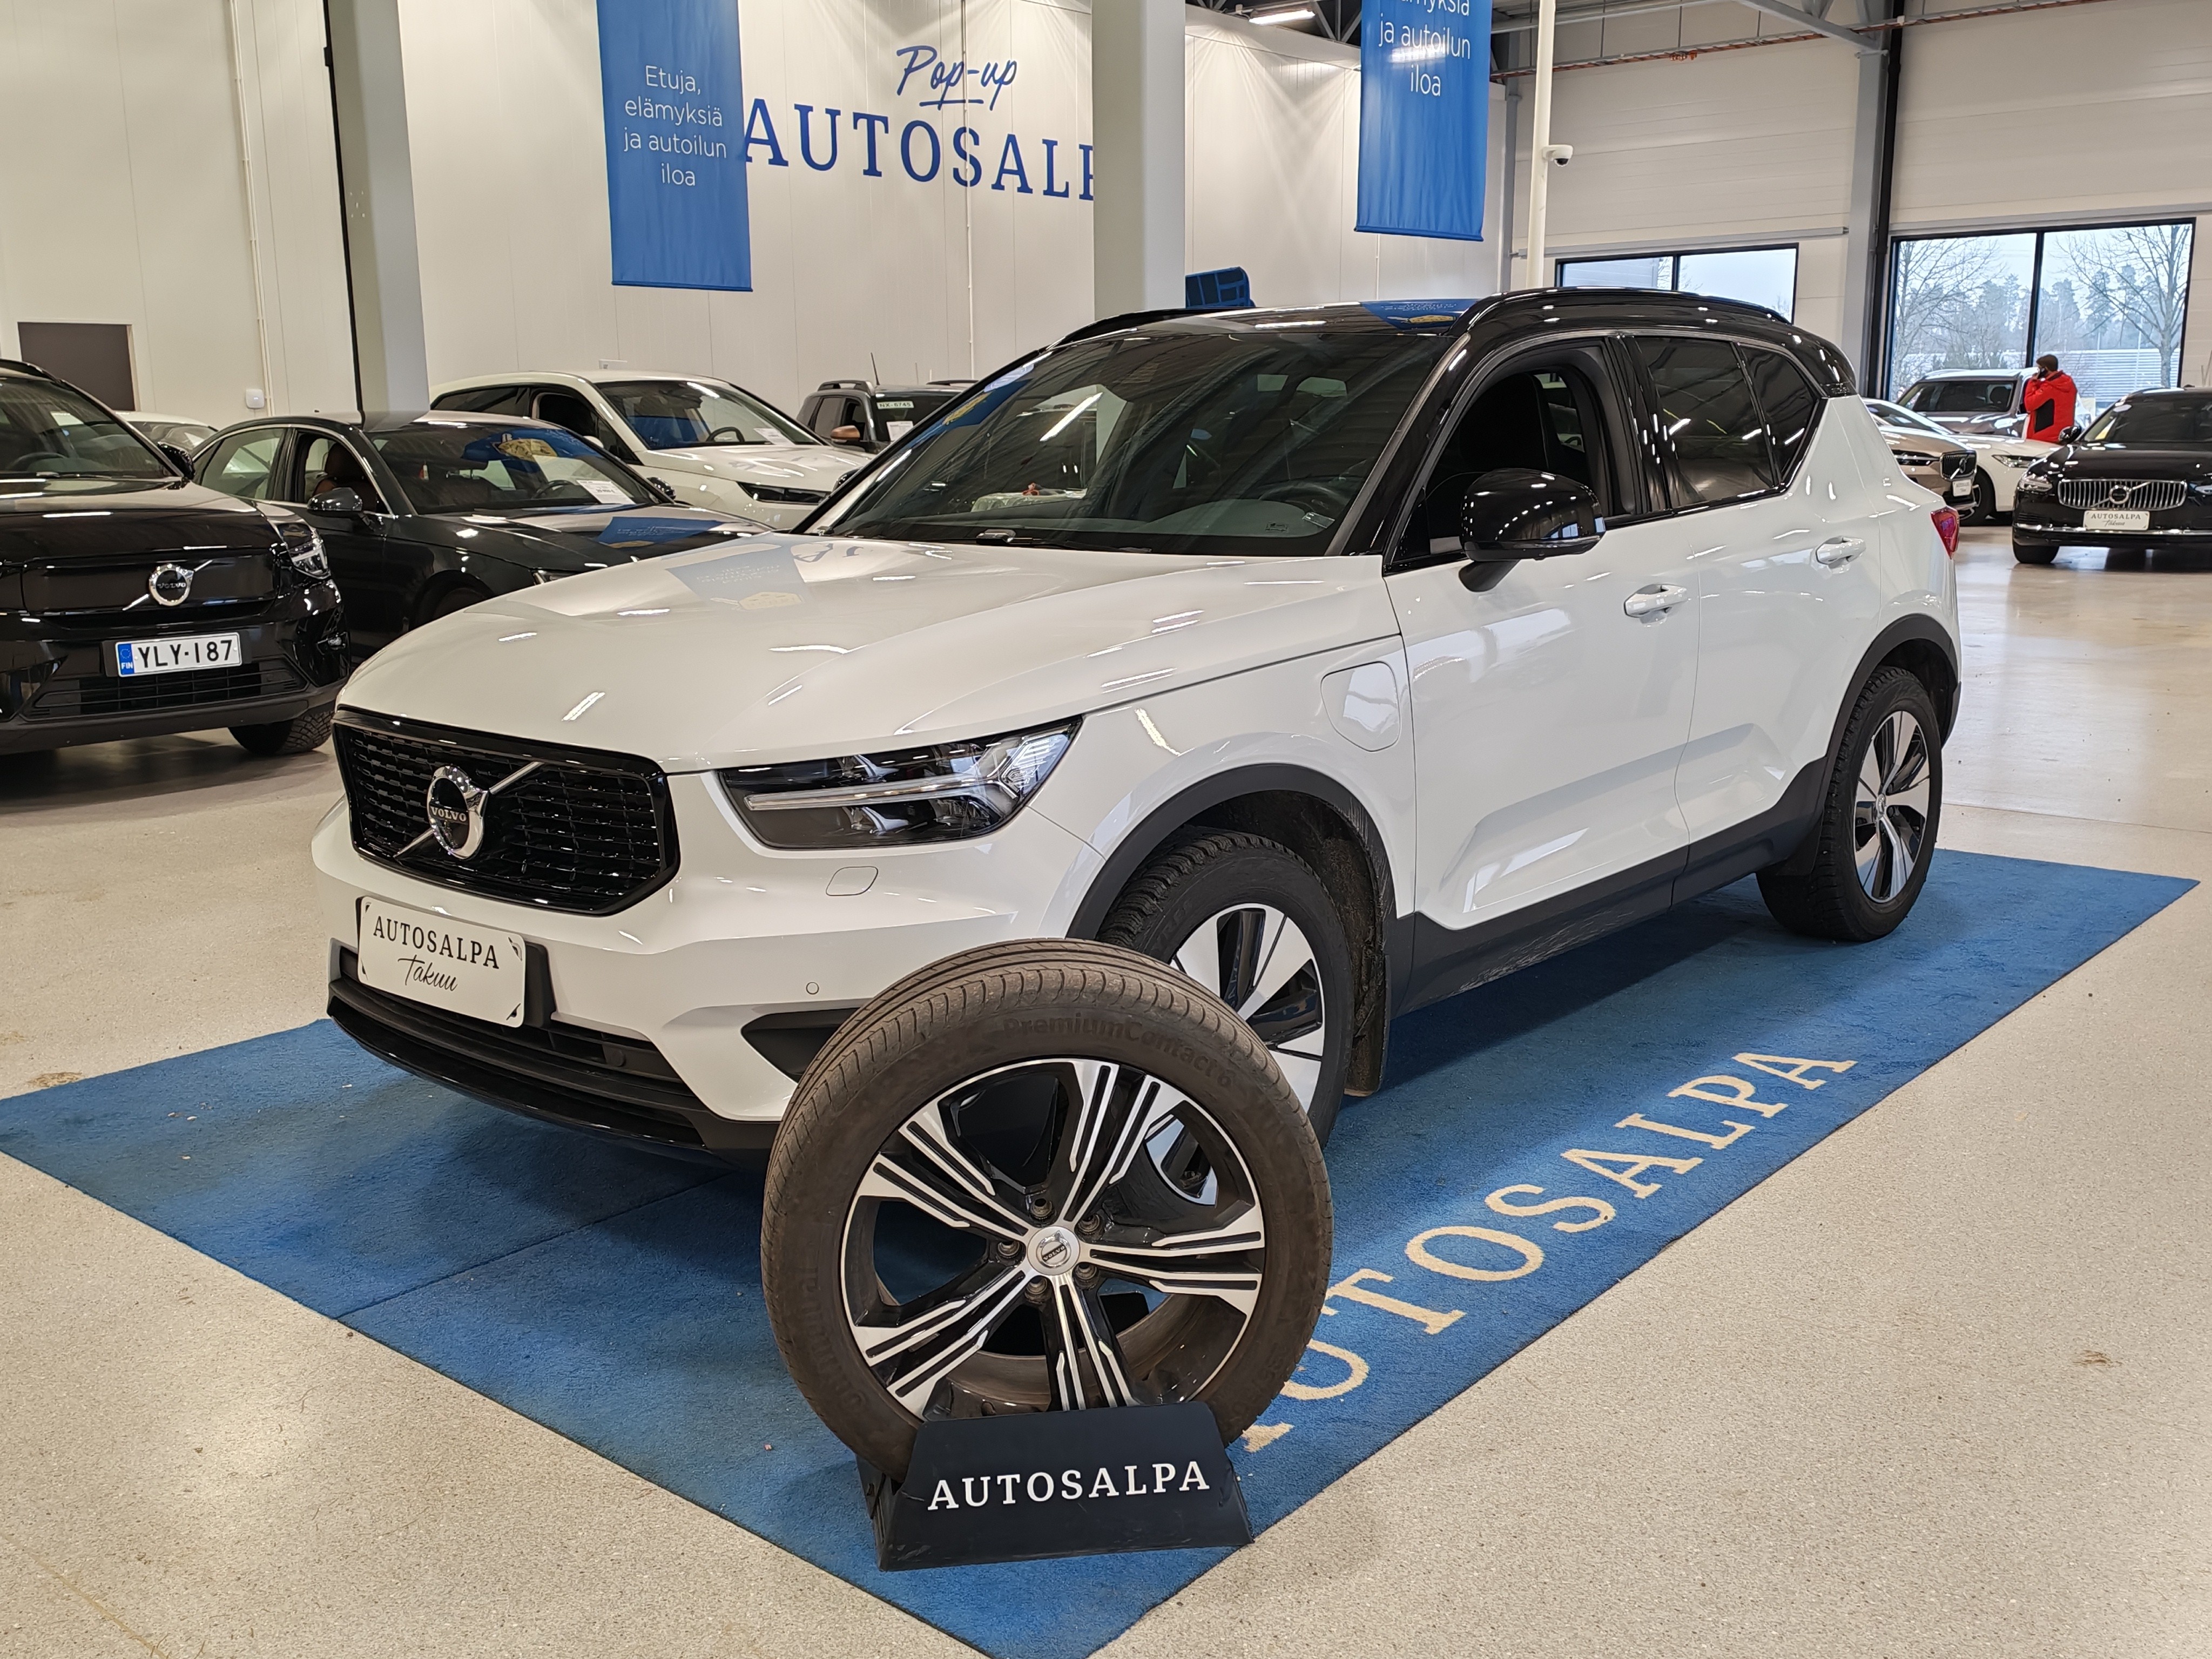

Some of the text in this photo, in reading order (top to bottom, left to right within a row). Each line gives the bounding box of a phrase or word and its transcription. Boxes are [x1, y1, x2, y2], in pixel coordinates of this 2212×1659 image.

[1378, 12, 1471, 60] ja autoilun
[645, 65, 702, 96] Etuja,
[896, 45, 1017, 111] Pop-up
[1410, 64, 1441, 97] iloa
[624, 95, 723, 127] elämyksiä
[623, 126, 727, 159] ja autoilun
[660, 162, 696, 187] iloa
[121, 662, 133, 670] FIN
[137, 639, 233, 669] YLY-187
[430, 806, 467, 822] VOLVO
[373, 915, 500, 970] AUTOSALPA
[397, 954, 458, 992] Takuu
[1003, 1012, 1219, 1078] PremiumContact
[1043, 1245, 1065, 1260] VOLVO
[1241, 1050, 1859, 1453] UTOSALPA
[927, 1460, 1210, 1511] AUTOSALPA
